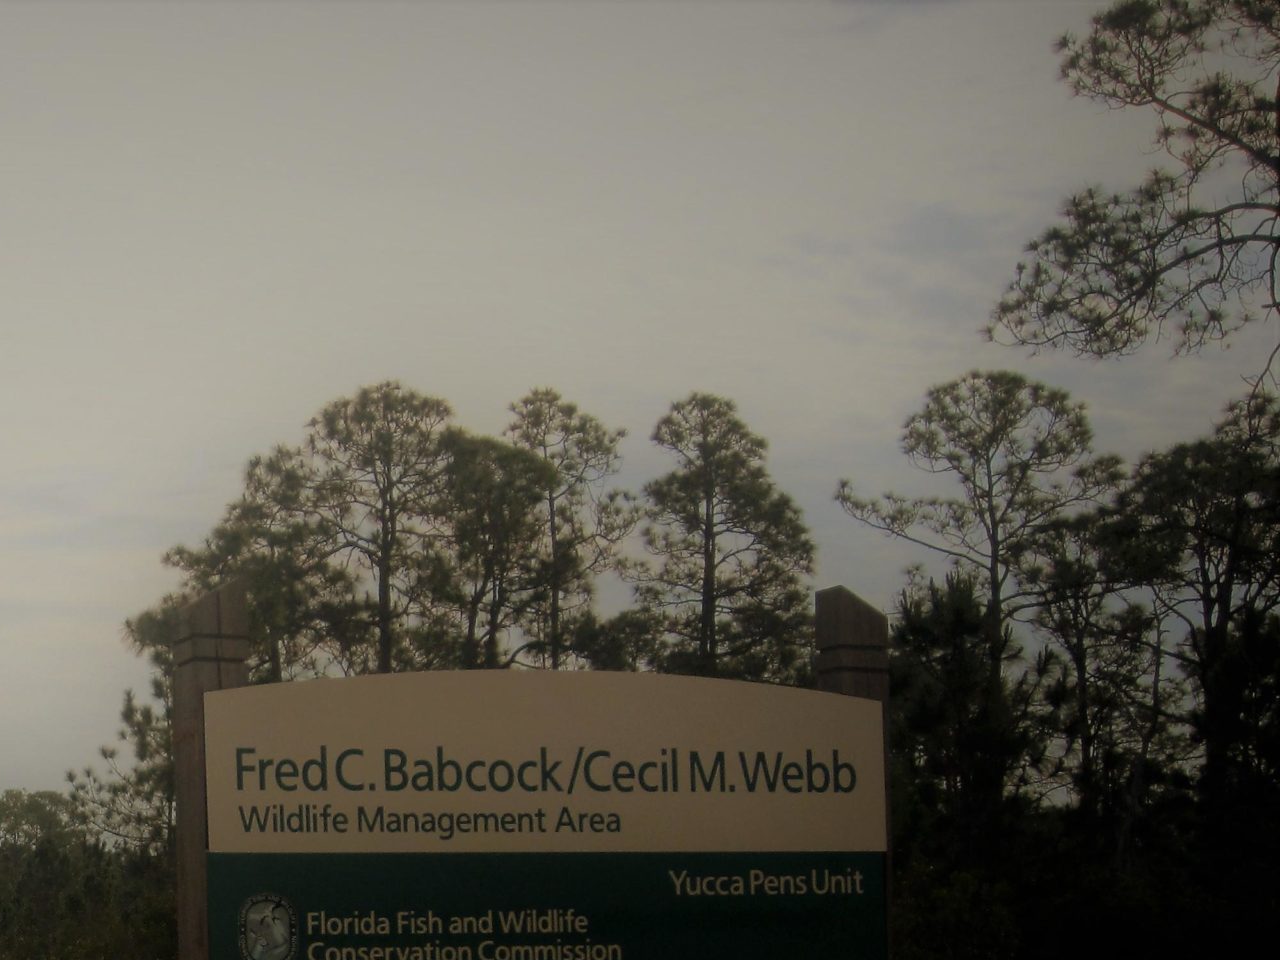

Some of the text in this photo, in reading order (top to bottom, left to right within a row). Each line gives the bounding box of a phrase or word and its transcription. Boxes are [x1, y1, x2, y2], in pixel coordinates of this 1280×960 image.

[235, 745, 327, 792] Fred
[335, 748, 376, 792] C.
[689, 750, 736, 792] M.
[738, 749, 857, 793] Webb
[238, 804, 621, 840] Wildlife Management Area
[668, 867, 864, 896] Yucca Pens Unit
[306, 908, 589, 936] Florida Fish and Wildlife
